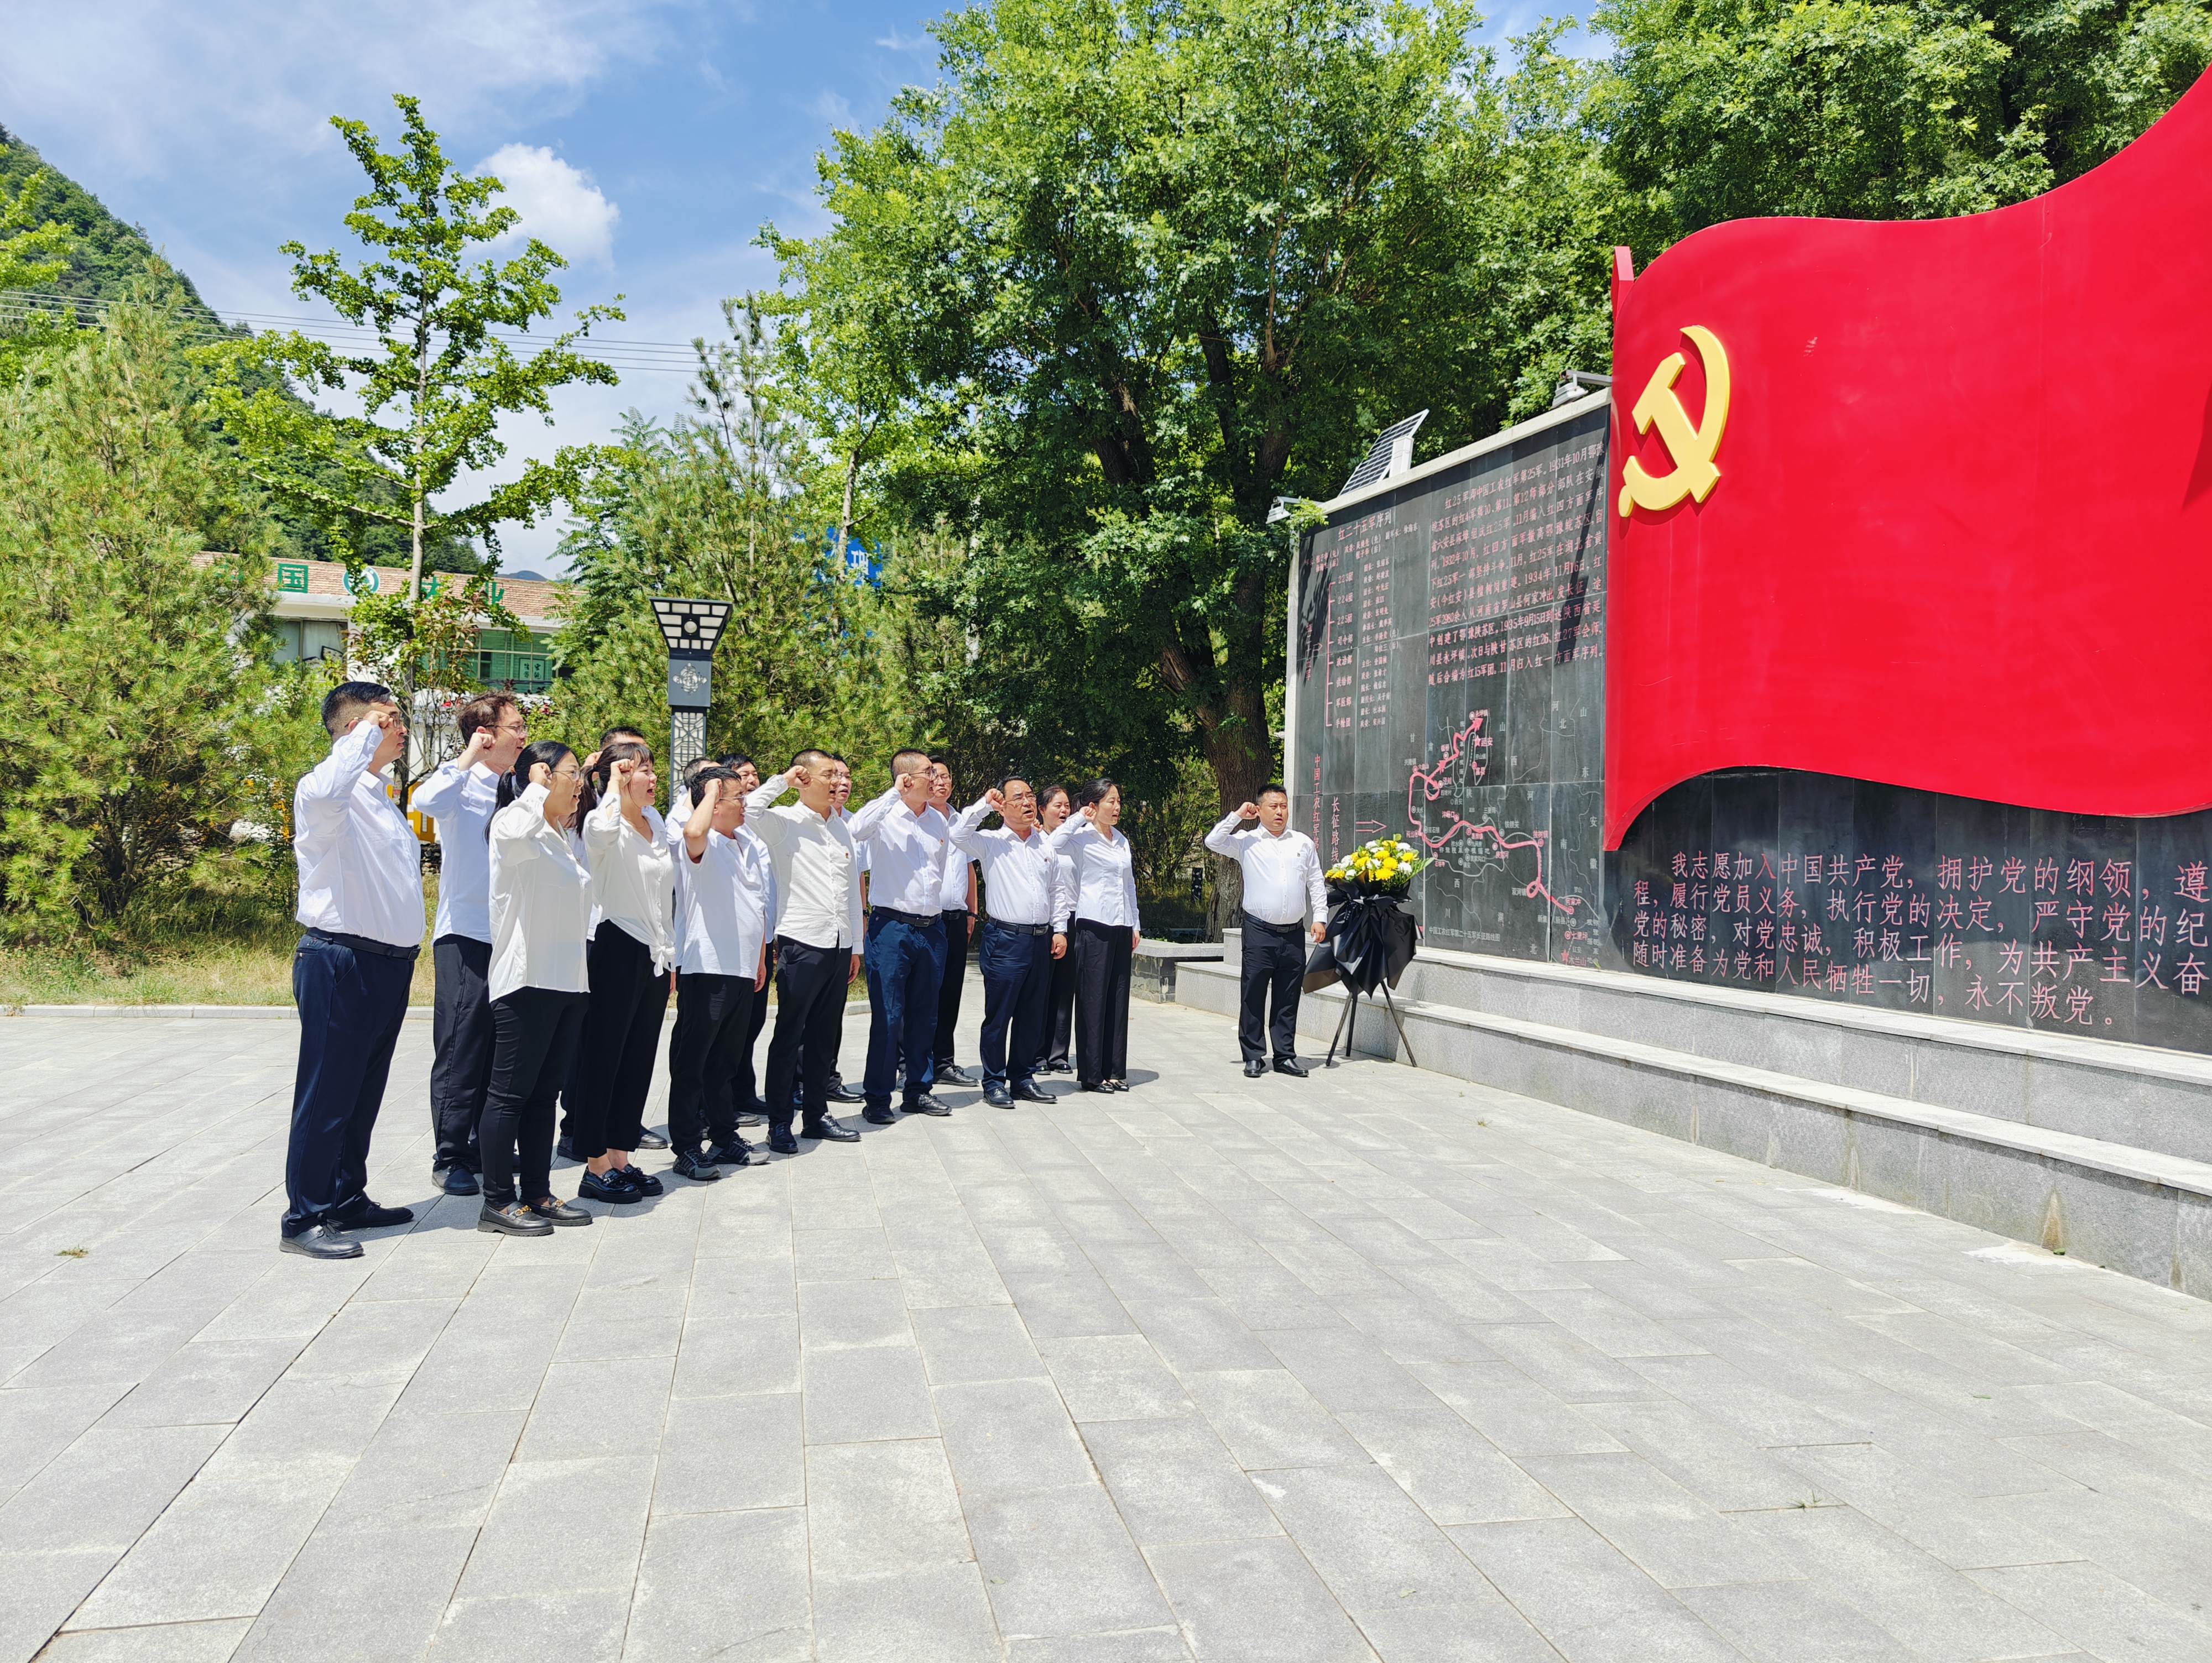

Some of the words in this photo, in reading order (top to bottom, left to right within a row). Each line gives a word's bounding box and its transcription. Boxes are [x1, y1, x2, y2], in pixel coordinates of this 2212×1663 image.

[1338, 510, 1391, 541] 红二十五军序列
[277, 563, 309, 594] 国
[1338, 571, 1353, 584] 223团
[1338, 592, 1353, 605] 224团
[1337, 613, 1353, 625] 225团
[1337, 634, 1353, 646] 司令部
[1336, 655, 1353, 667] 政治部
[1336, 676, 1352, 688] 供给部
[1335, 696, 1352, 708] 军医部
[1335, 718, 1351, 728] 手枪团
